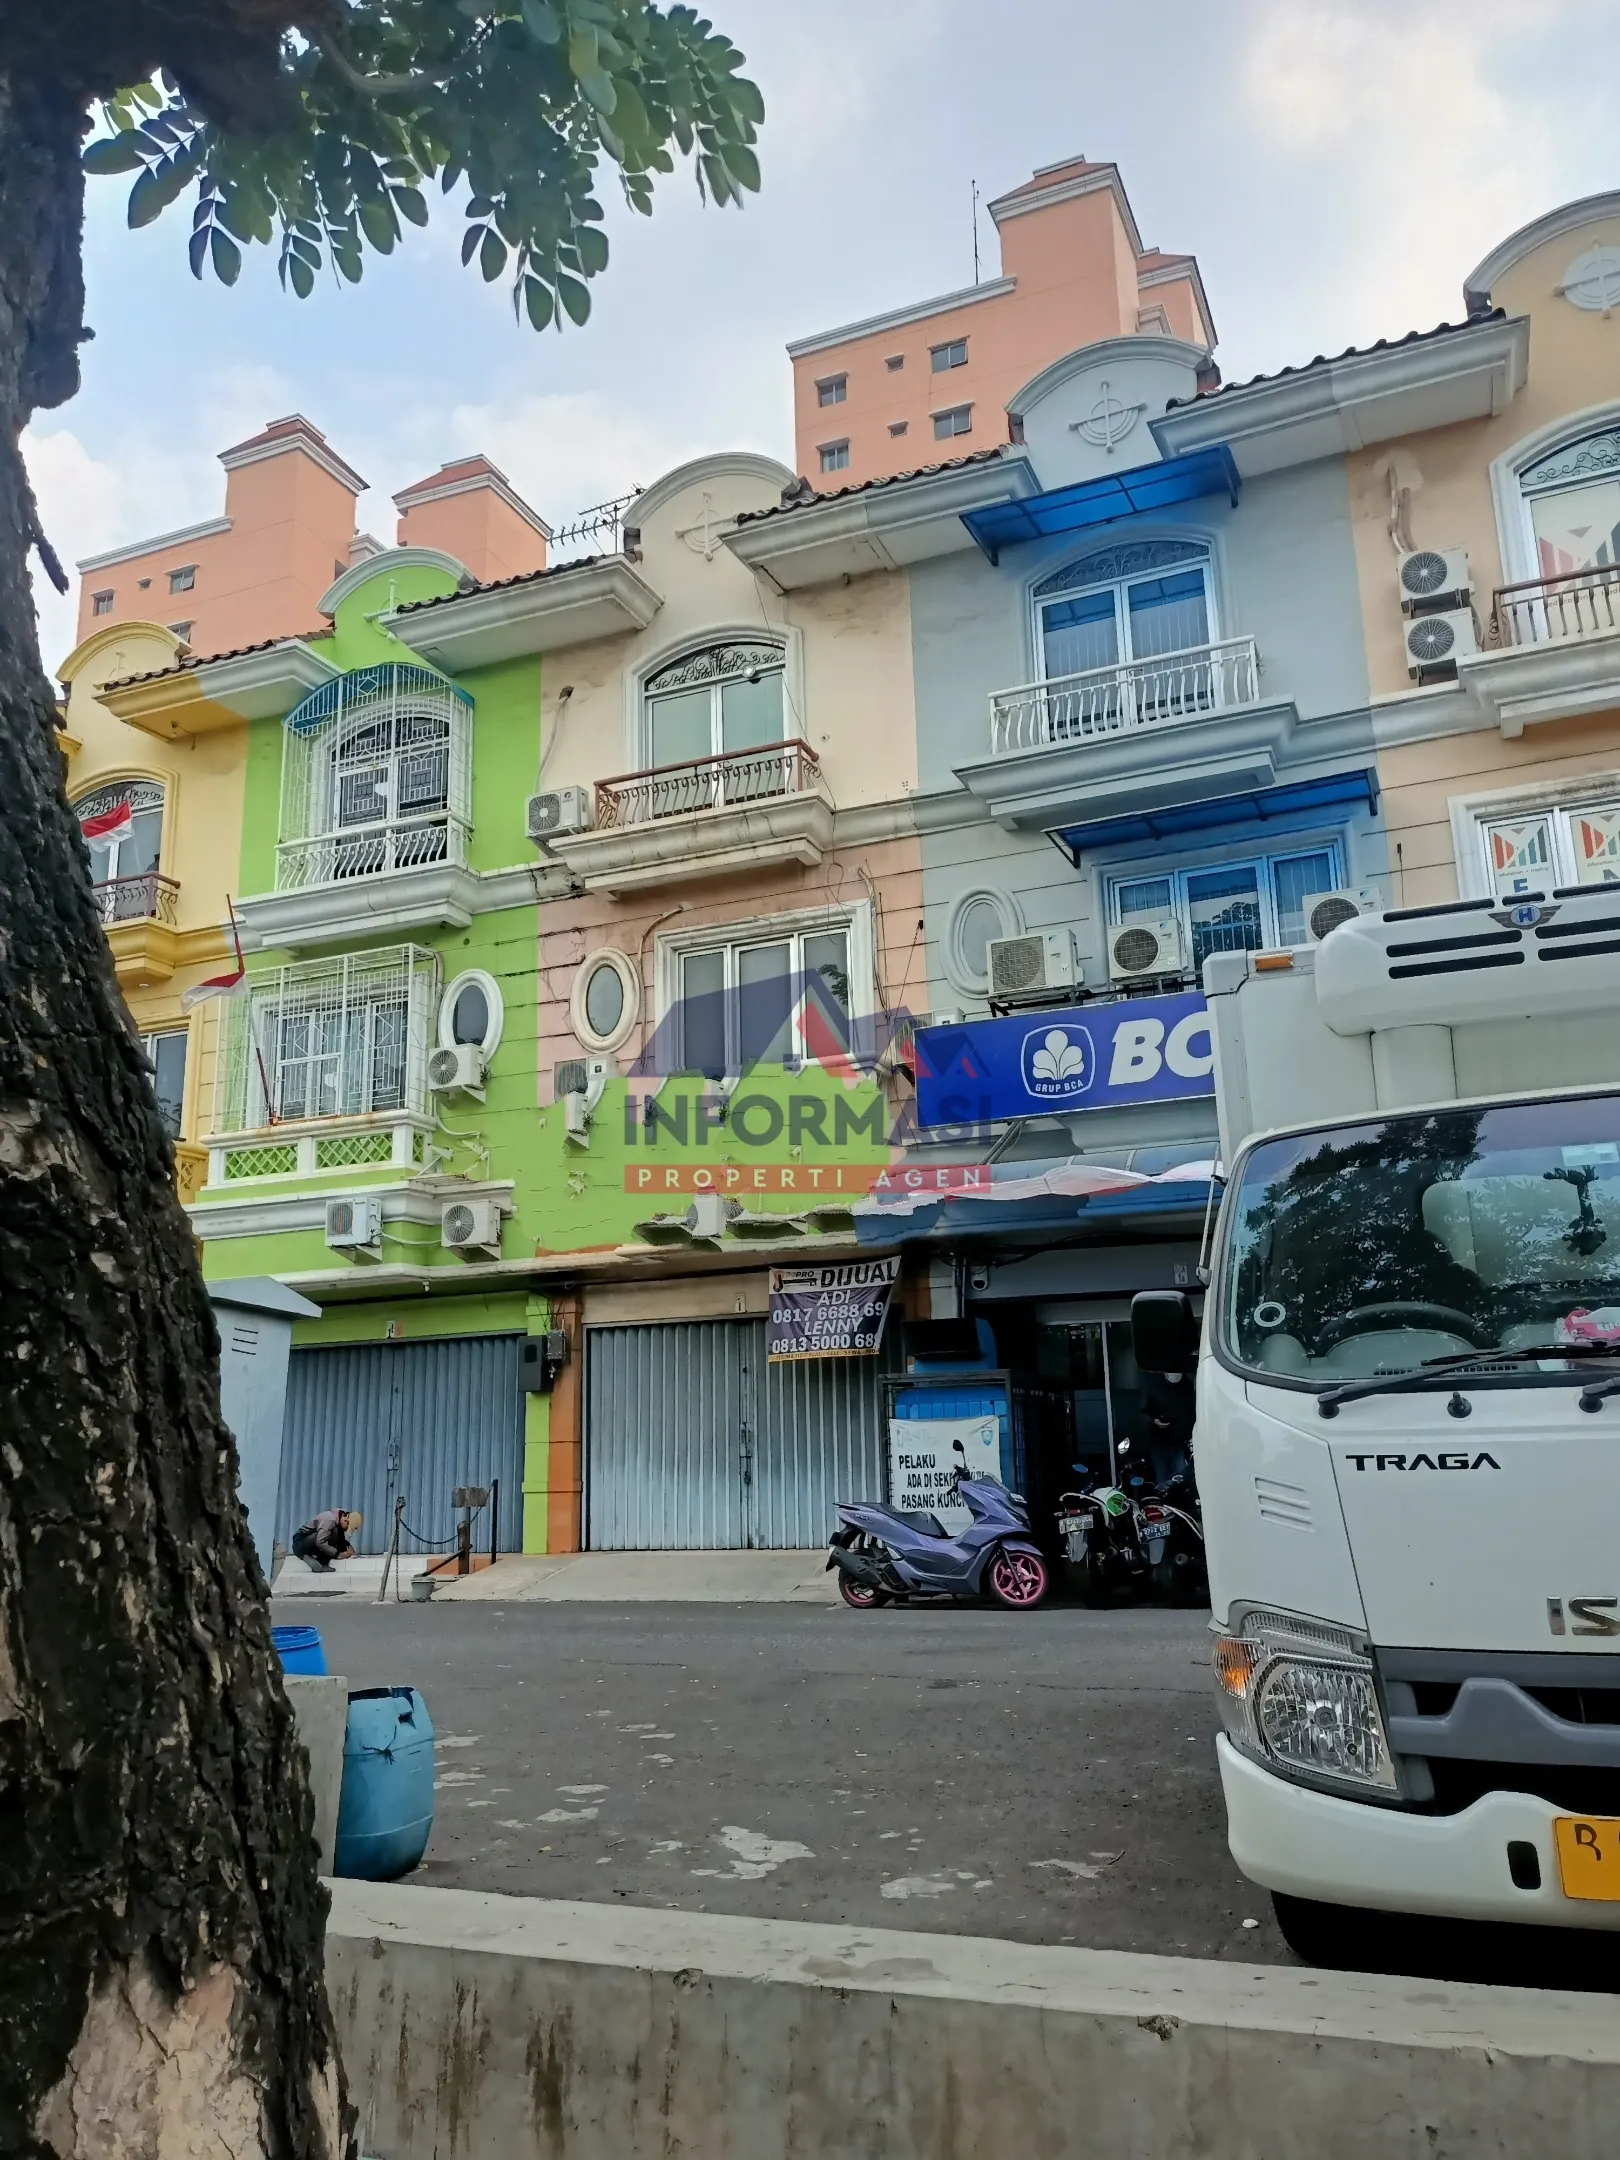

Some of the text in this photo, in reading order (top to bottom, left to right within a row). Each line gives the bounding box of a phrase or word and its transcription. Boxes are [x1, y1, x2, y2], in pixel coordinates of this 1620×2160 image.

[1035, 1079, 1084, 1093] GRUP BCA
[821, 1261, 896, 1288] DIJUAL
[816, 1289, 851, 1306] ADI
[773, 1308, 813, 1324] 0817
[817, 1304, 859, 1320] 6688
[804, 1317, 863, 1336] LENNY
[772, 1333, 876, 1354] 0813 5000 68
[899, 1454, 935, 1469] PELAKU
[1345, 1453, 1501, 1471] TRAGA
[907, 1473, 922, 1488] ADA
[924, 1473, 932, 1488] DI
[901, 1493, 934, 1509] PASANG
[1546, 1596, 1620, 1636] IS
